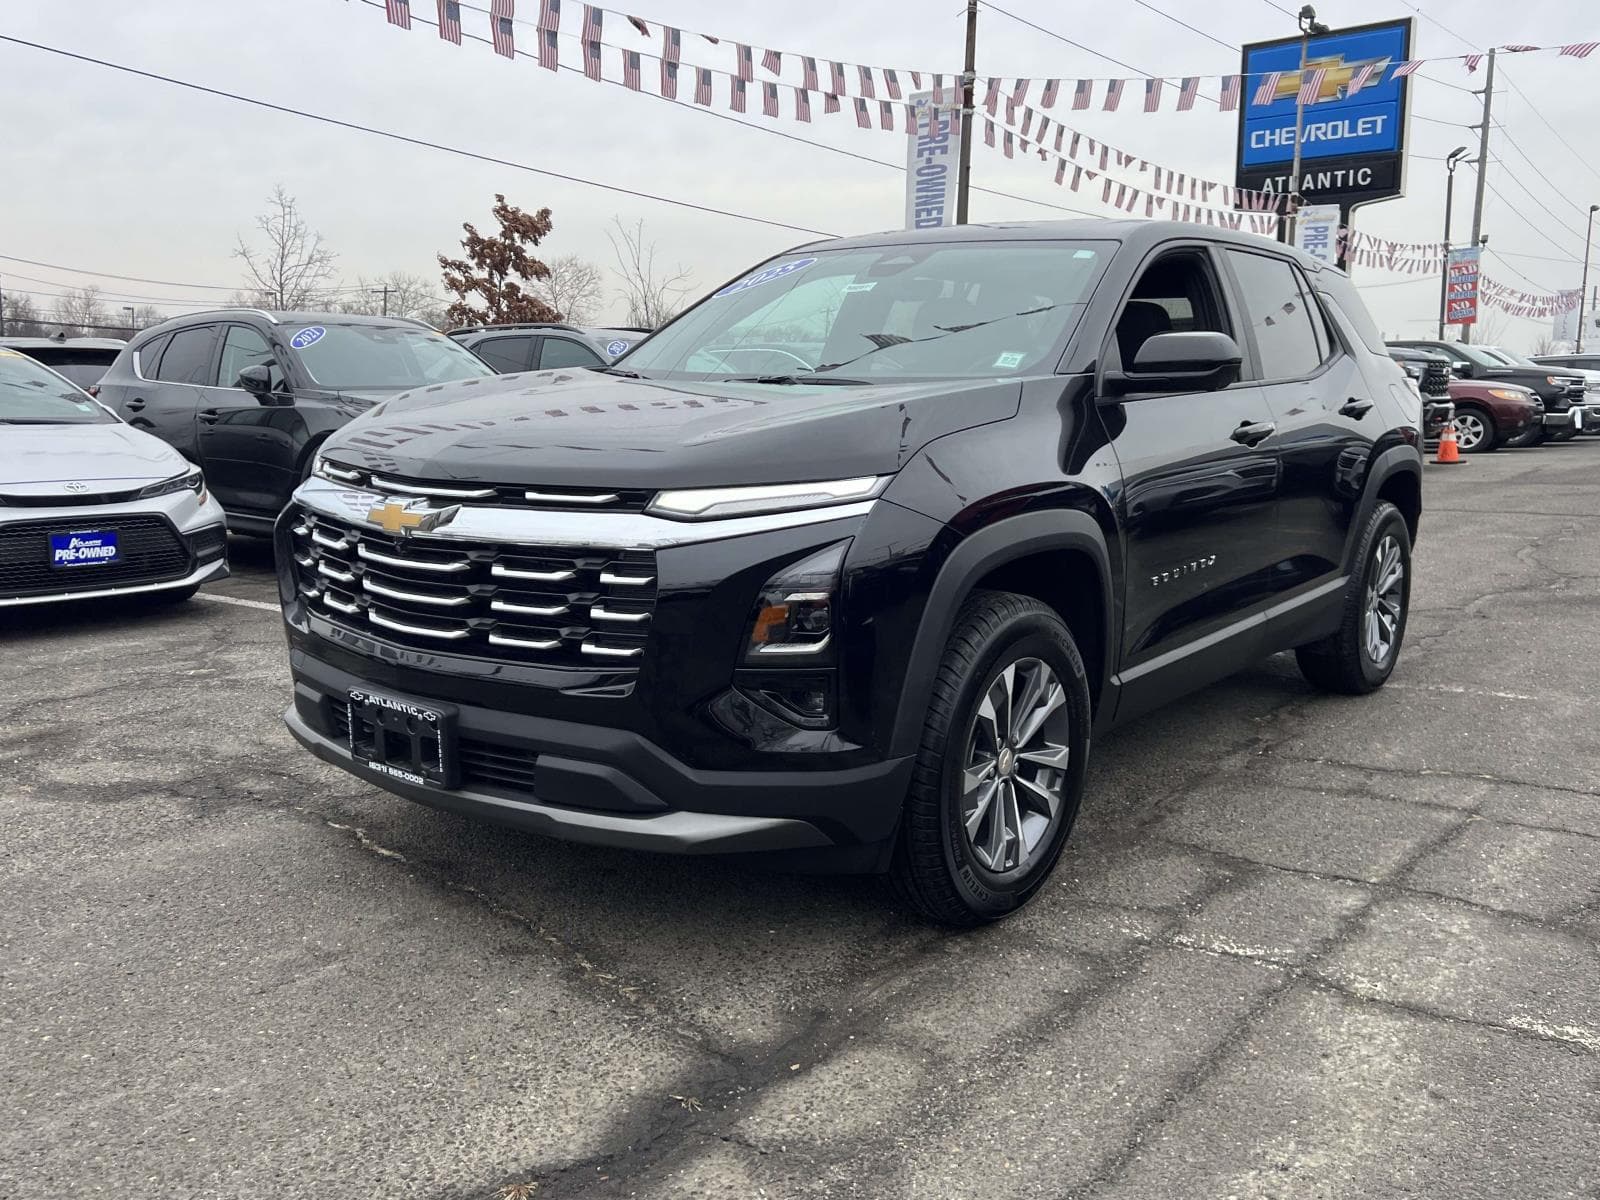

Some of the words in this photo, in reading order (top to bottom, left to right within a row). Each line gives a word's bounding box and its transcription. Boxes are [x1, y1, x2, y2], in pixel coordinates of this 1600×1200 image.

[1251, 115, 1387, 149] CHEVROLET
[914, 119, 950, 230] PRE-OWNED
[1262, 167, 1372, 194] ATLANTIC
[1454, 283, 1472, 292] NO
[1451, 301, 1470, 311] NO
[55, 546, 116, 561] PRE-OWNED
[368, 695, 418, 716] ATLANTIC
